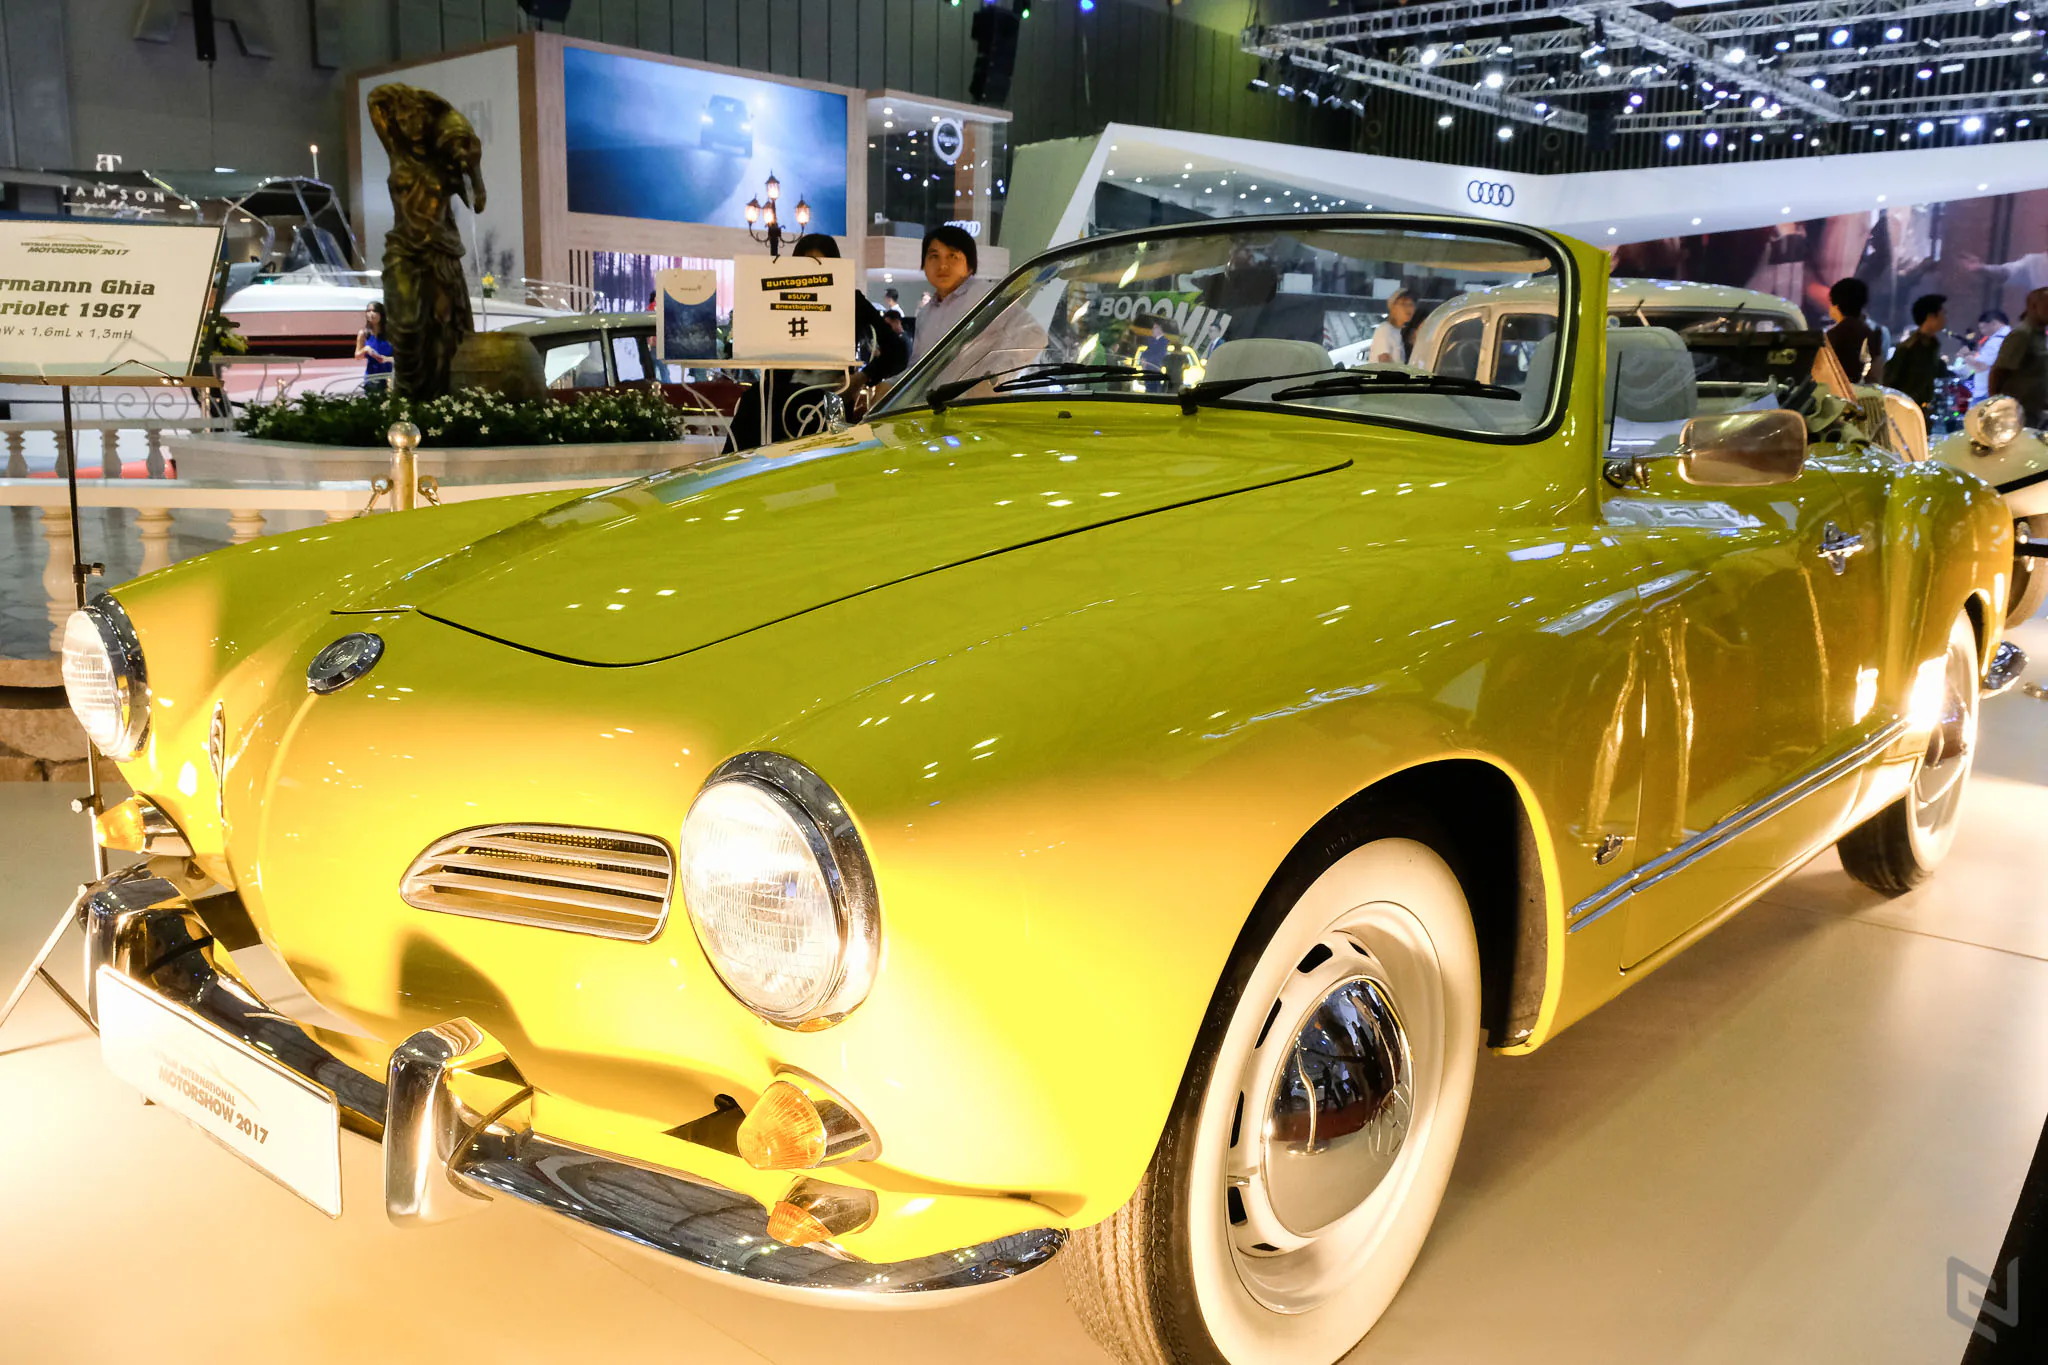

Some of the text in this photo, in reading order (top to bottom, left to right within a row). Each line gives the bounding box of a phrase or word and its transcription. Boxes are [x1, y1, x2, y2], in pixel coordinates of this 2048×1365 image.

[61, 184, 165, 203] TAMSON
[27, 247, 130, 256] MOTORSHOW 2017
[100, 279, 156, 296] Ghia
[766, 276, 828, 287] #untaggable
[79, 302, 142, 320] 1967
[159, 1065, 269, 1145] MOTORSHOW 2017
